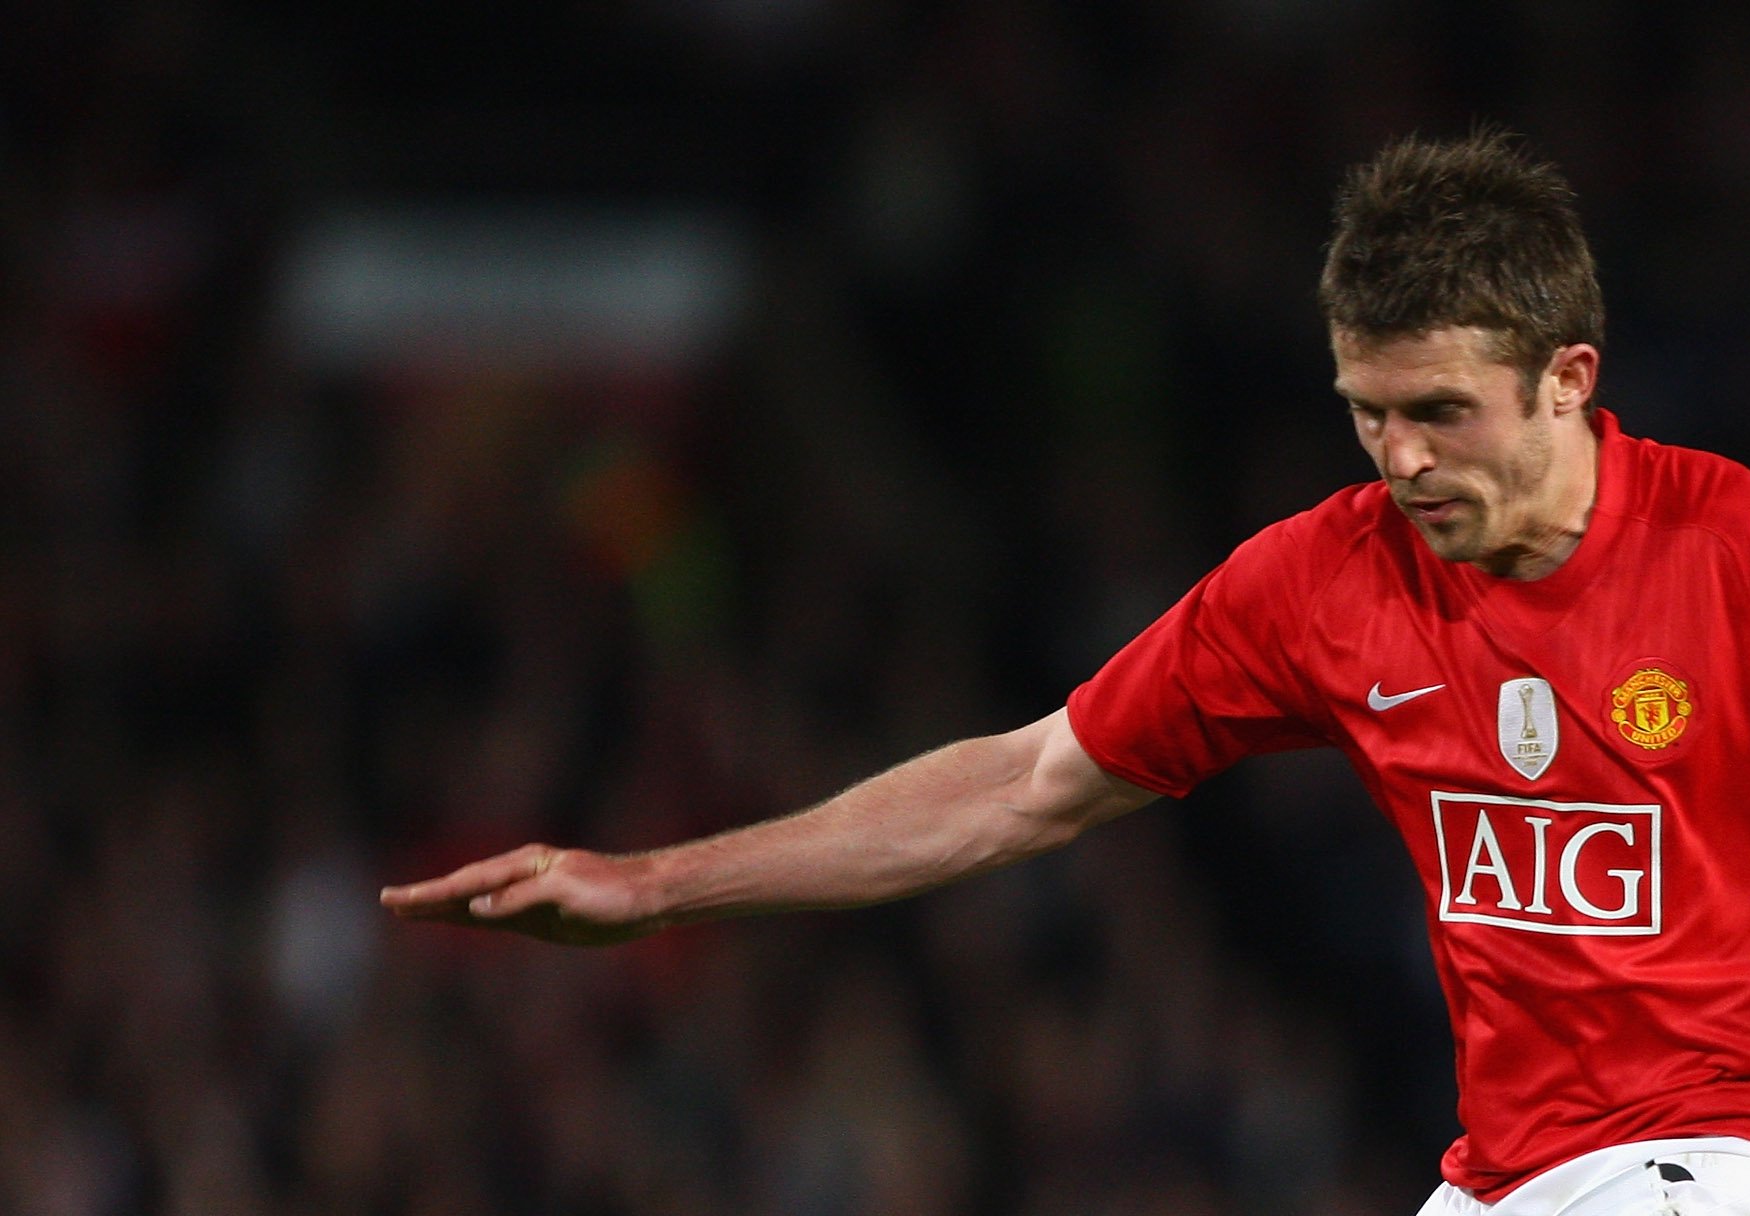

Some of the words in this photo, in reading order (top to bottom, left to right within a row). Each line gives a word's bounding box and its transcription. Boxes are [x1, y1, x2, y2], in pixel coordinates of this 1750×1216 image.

[1631, 727, 1676, 744] UNITED
[1518, 743, 1541, 753] FIFA
[1455, 809, 1644, 919] AIG
